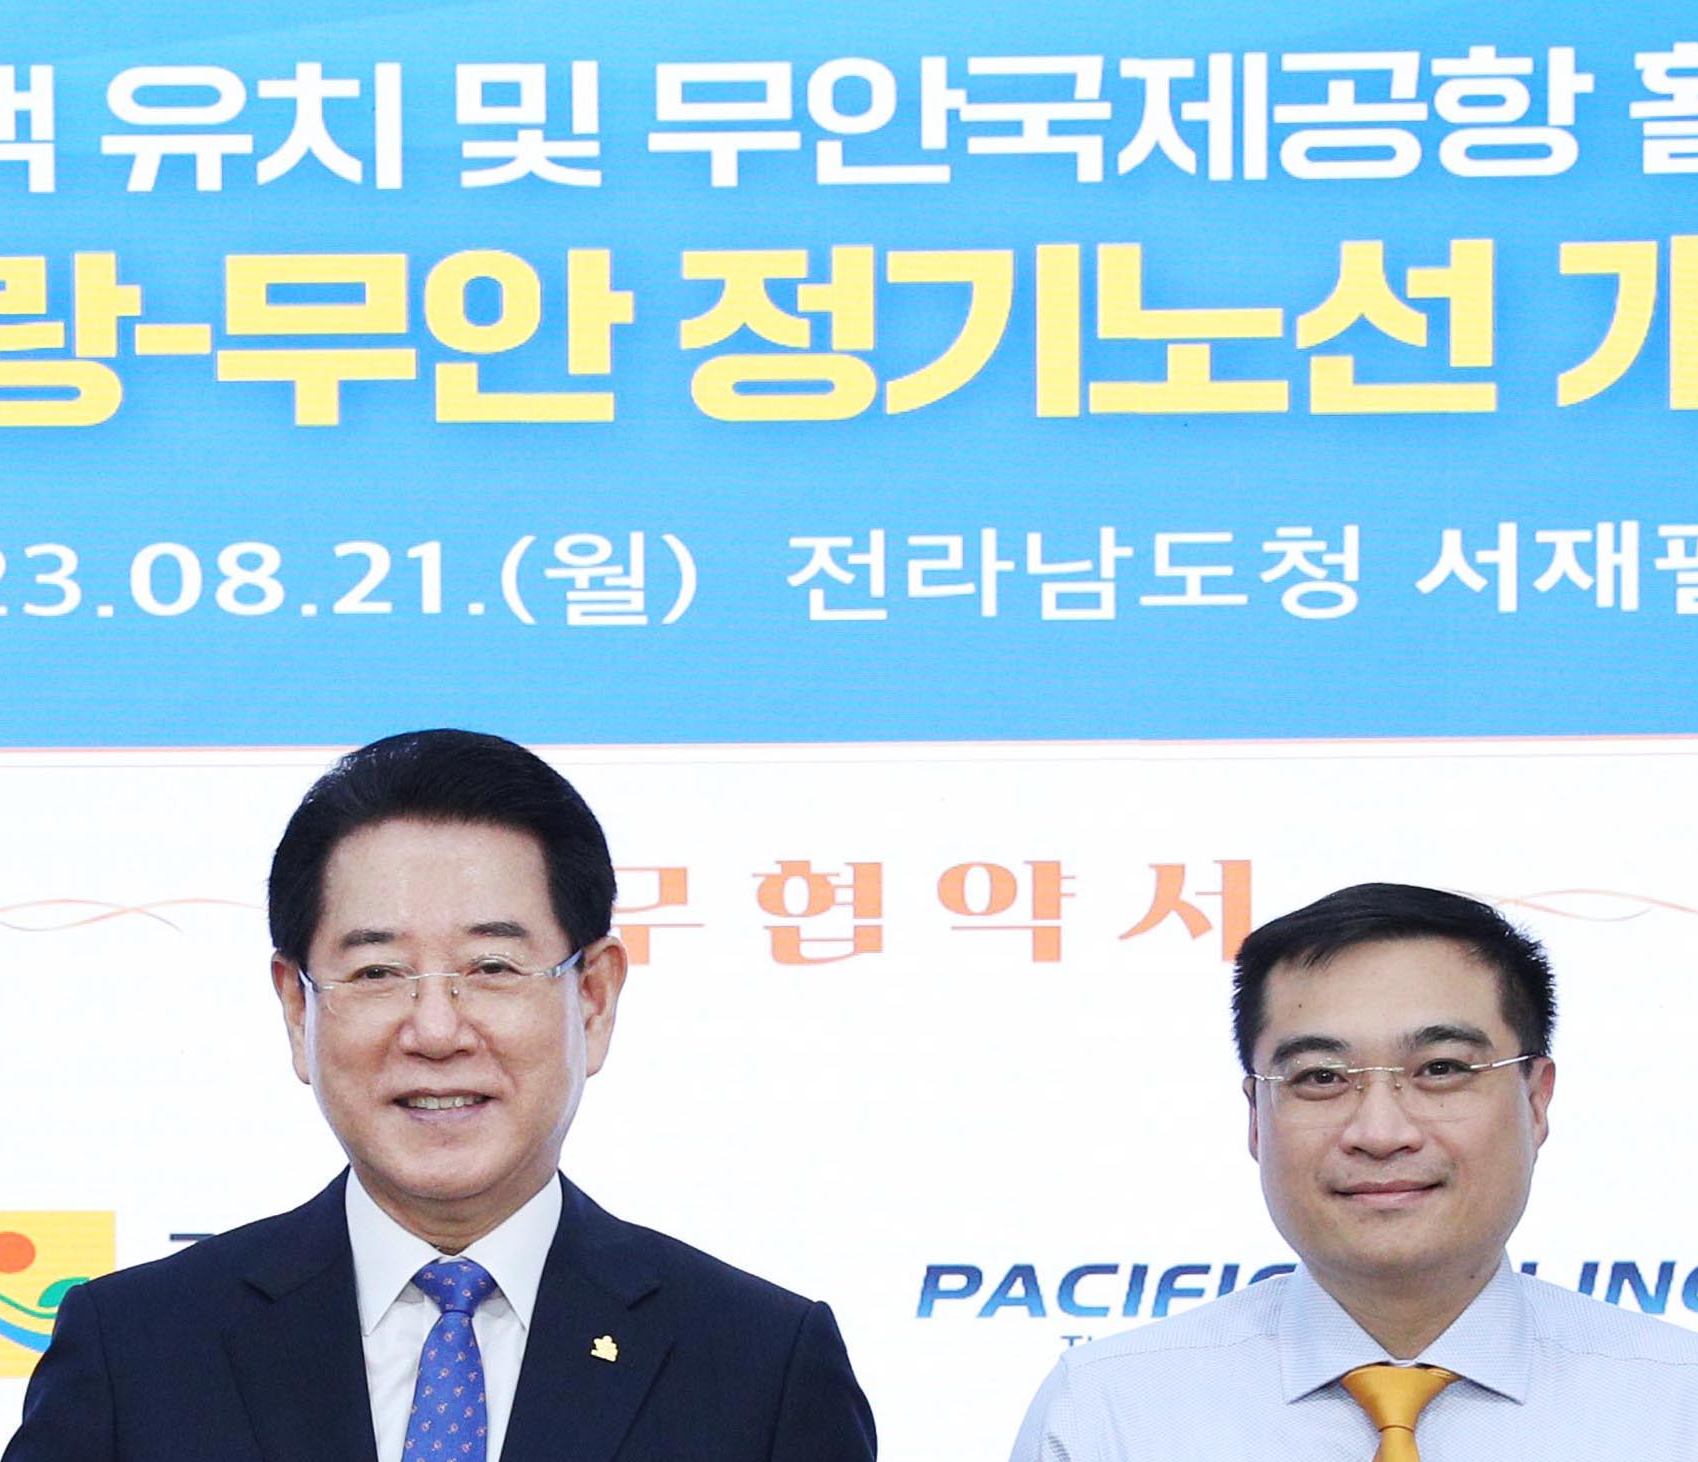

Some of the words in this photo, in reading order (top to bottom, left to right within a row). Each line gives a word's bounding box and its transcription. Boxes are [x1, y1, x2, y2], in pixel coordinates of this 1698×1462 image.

[102, 63, 402, 191] 유치
[456, 61, 601, 186] 및
[649, 46, 1593, 186] 무안국제공항
[680, 239, 1498, 421] 정기노선
[787, 524, 1360, 621] 전라남도청
[915, 1263, 1299, 1318] PACIFI
